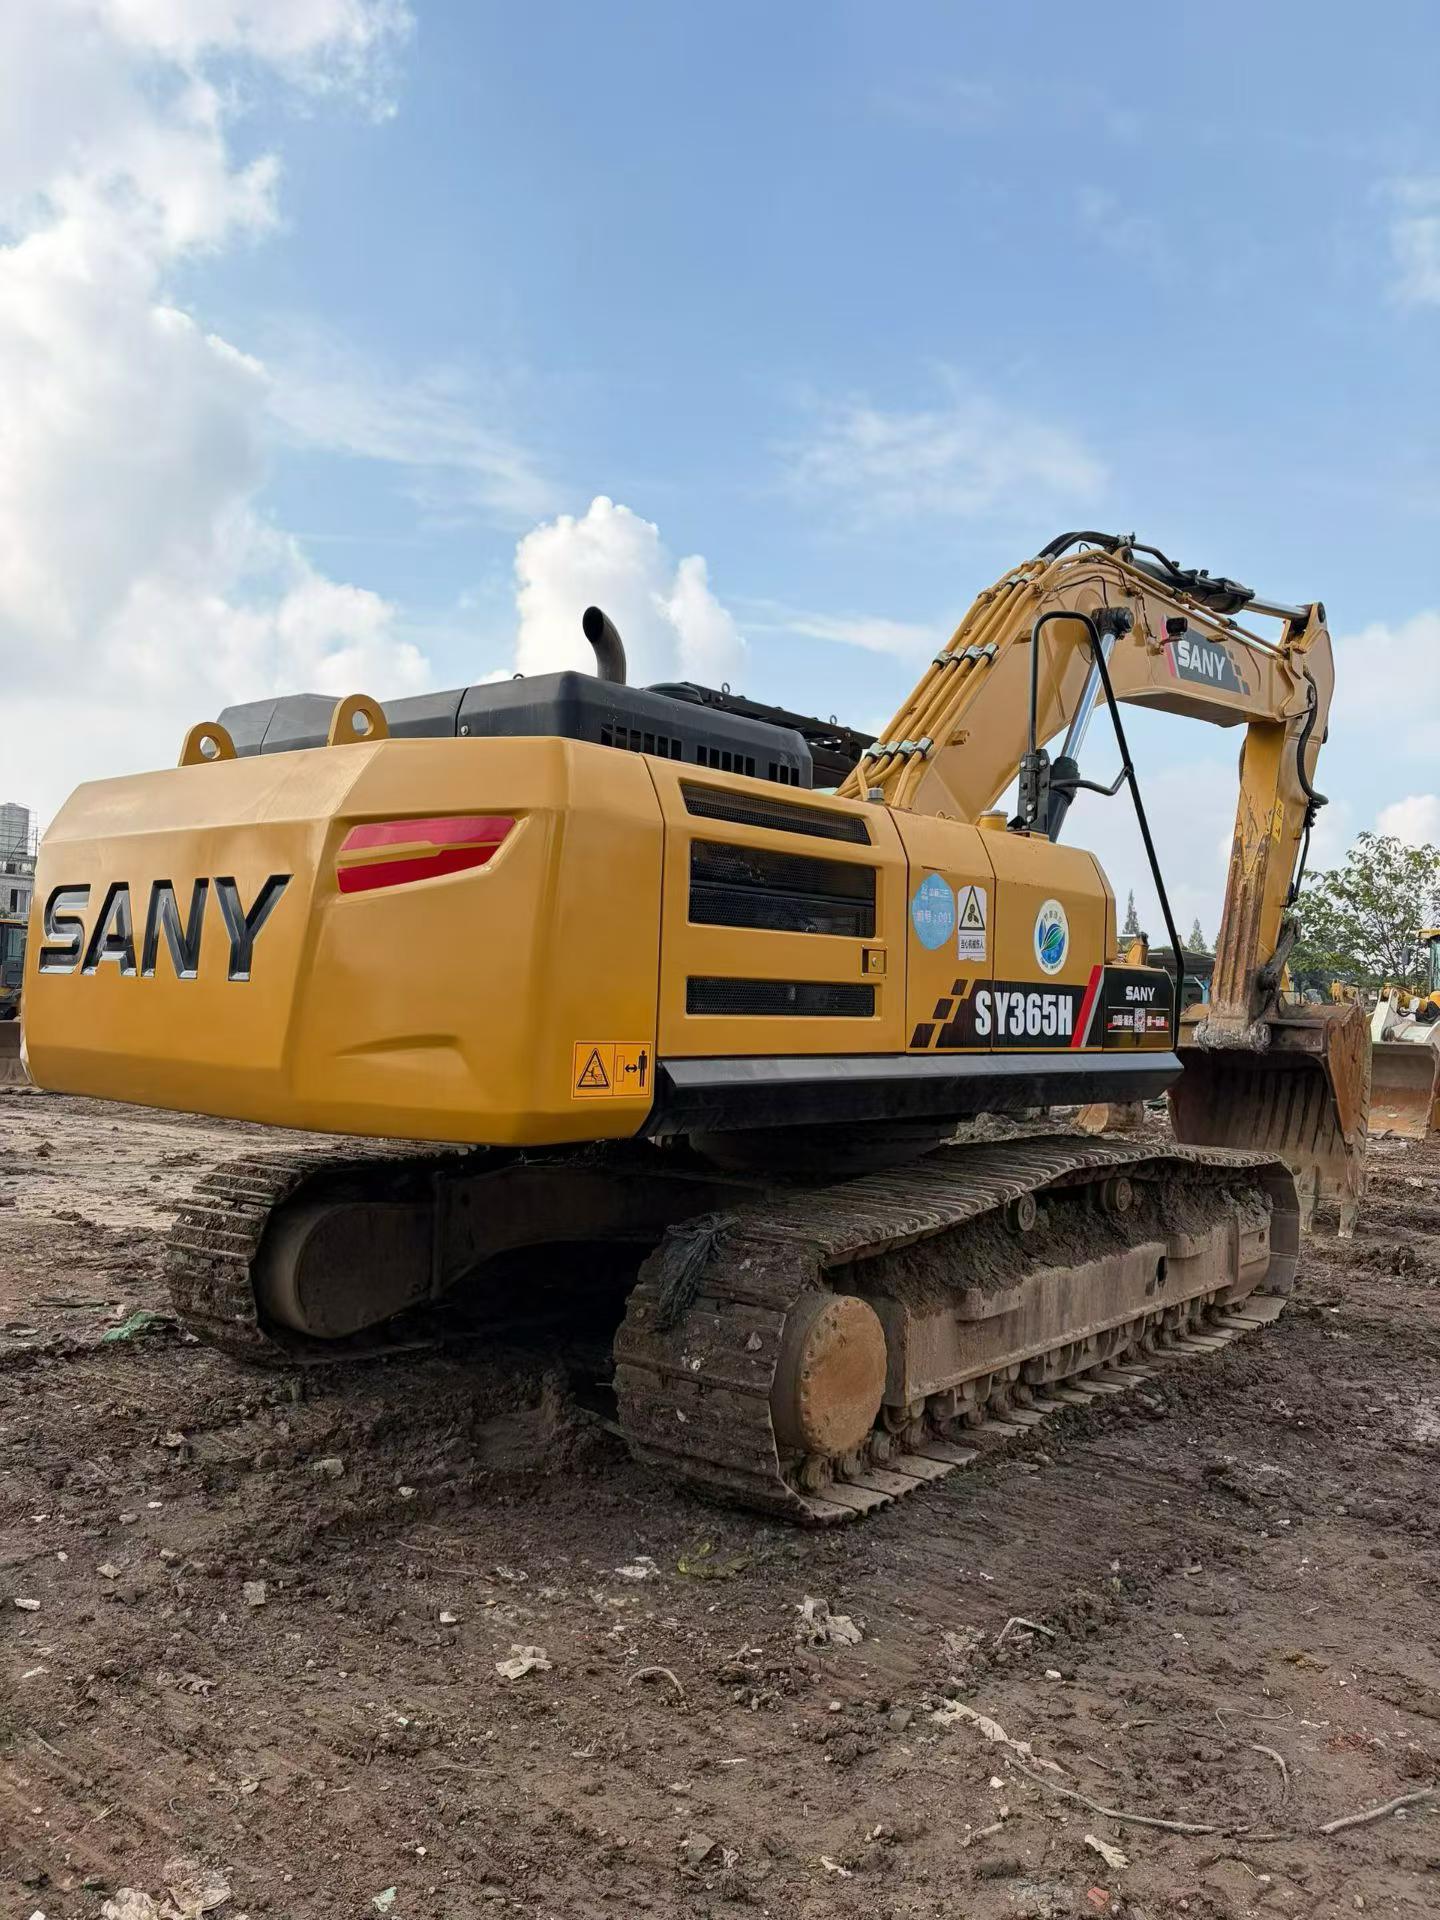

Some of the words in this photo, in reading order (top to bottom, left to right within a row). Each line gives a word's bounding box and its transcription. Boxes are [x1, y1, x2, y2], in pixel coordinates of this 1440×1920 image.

[1177, 640, 1226, 681] SANY
[38, 873, 295, 982] SANY
[975, 990, 1073, 1036] SY365H
[1125, 985, 1156, 1002] SANY
